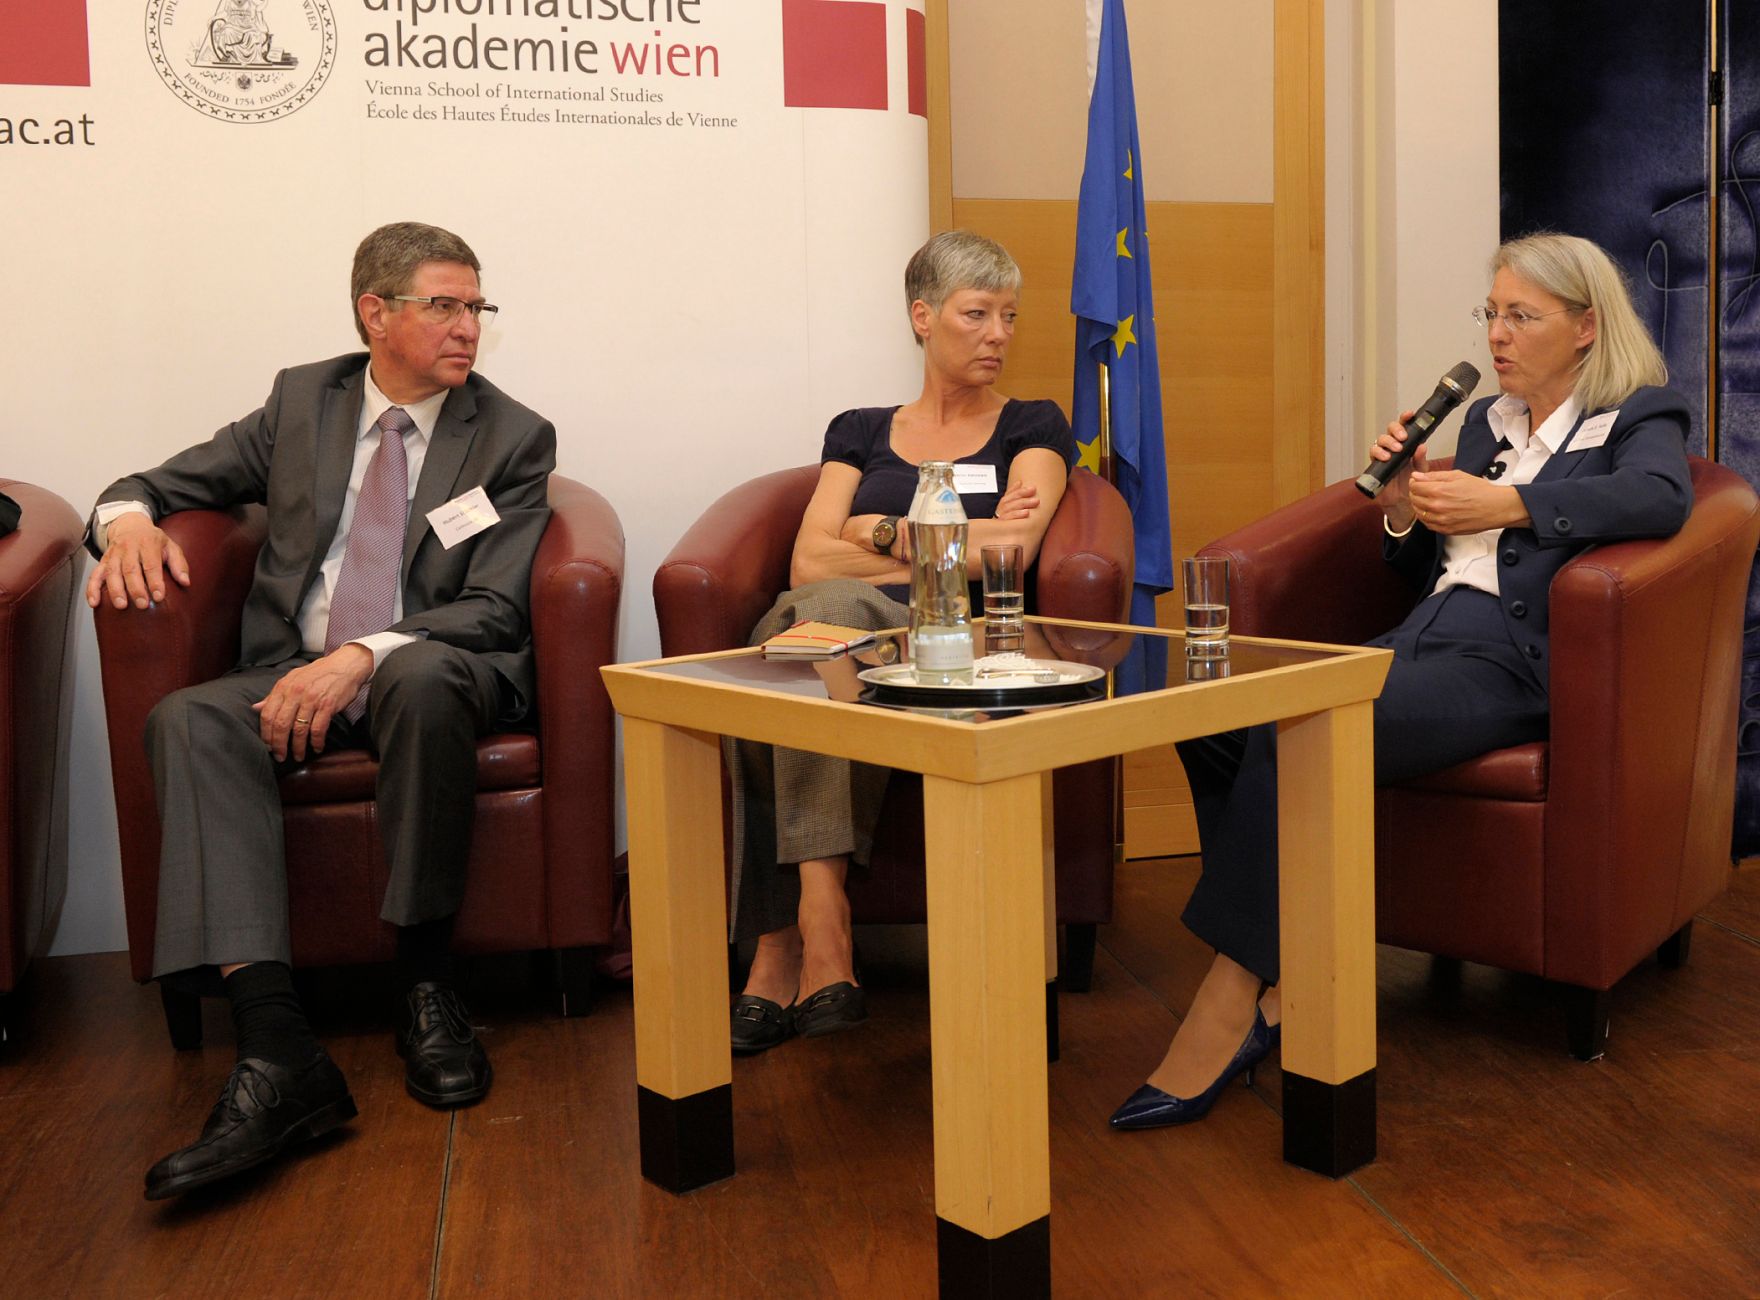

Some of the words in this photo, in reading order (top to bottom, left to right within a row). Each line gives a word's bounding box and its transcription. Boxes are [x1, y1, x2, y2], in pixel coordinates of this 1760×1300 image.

[364, 20, 598, 74] akademie
[609, 30, 719, 77] wien
[184, 72, 230, 103] FOUNDED
[235, 97, 255, 106] 1754
[259, 81, 297, 104] FONDÉE
[365, 80, 422, 96] Vienna
[427, 81, 480, 98] School
[485, 83, 503, 98] of
[506, 84, 605, 101] International
[610, 87, 664, 103] Studies
[0, 113, 96, 146] ac.at
[366, 100, 408, 120] École
[412, 104, 438, 120] des
[442, 105, 495, 122] Hautes
[500, 104, 551, 123] Études
[555, 108, 662, 127] Internationales
[666, 112, 684, 127] de
[687, 112, 738, 128] Vienne
